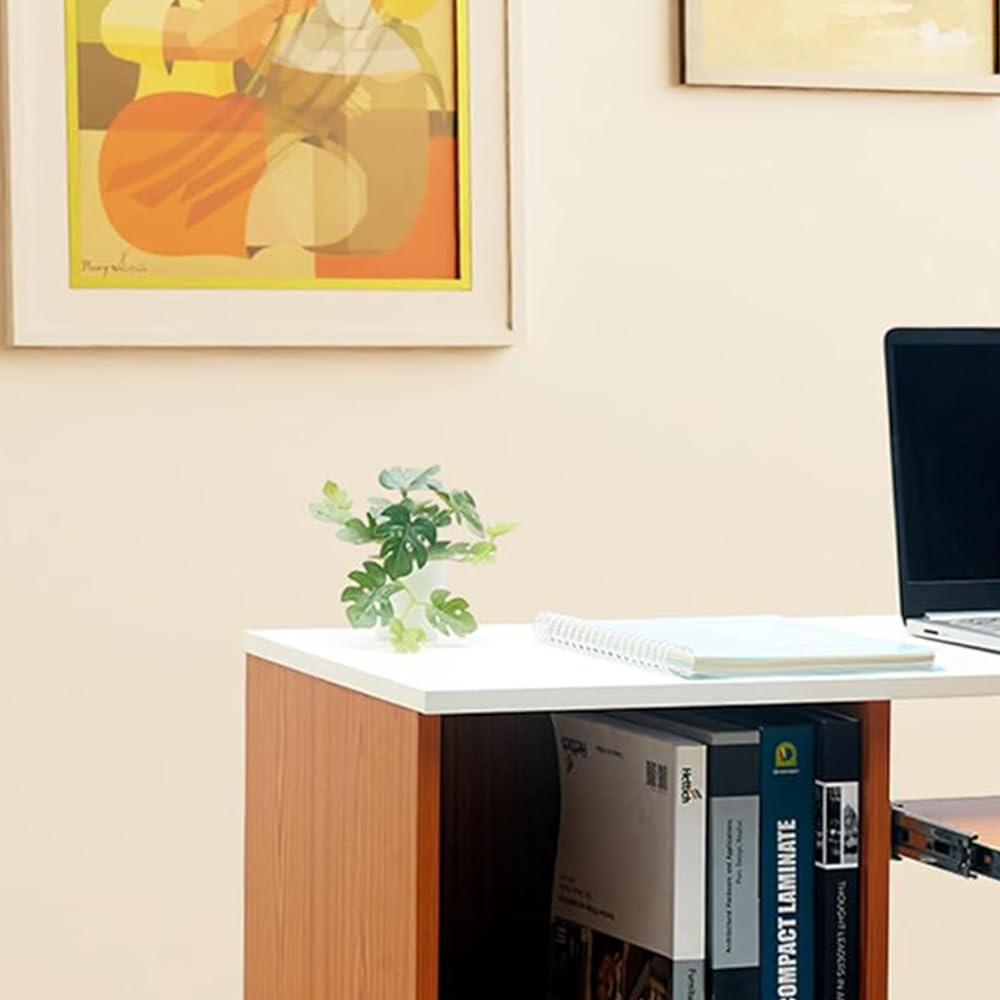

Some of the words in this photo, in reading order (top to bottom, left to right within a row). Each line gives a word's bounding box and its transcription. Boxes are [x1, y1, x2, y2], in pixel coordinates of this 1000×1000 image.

[776, 819, 797, 914] LAMINATE
[836, 880, 847, 929] THOUGHT
[836, 978, 847, 990] IN
